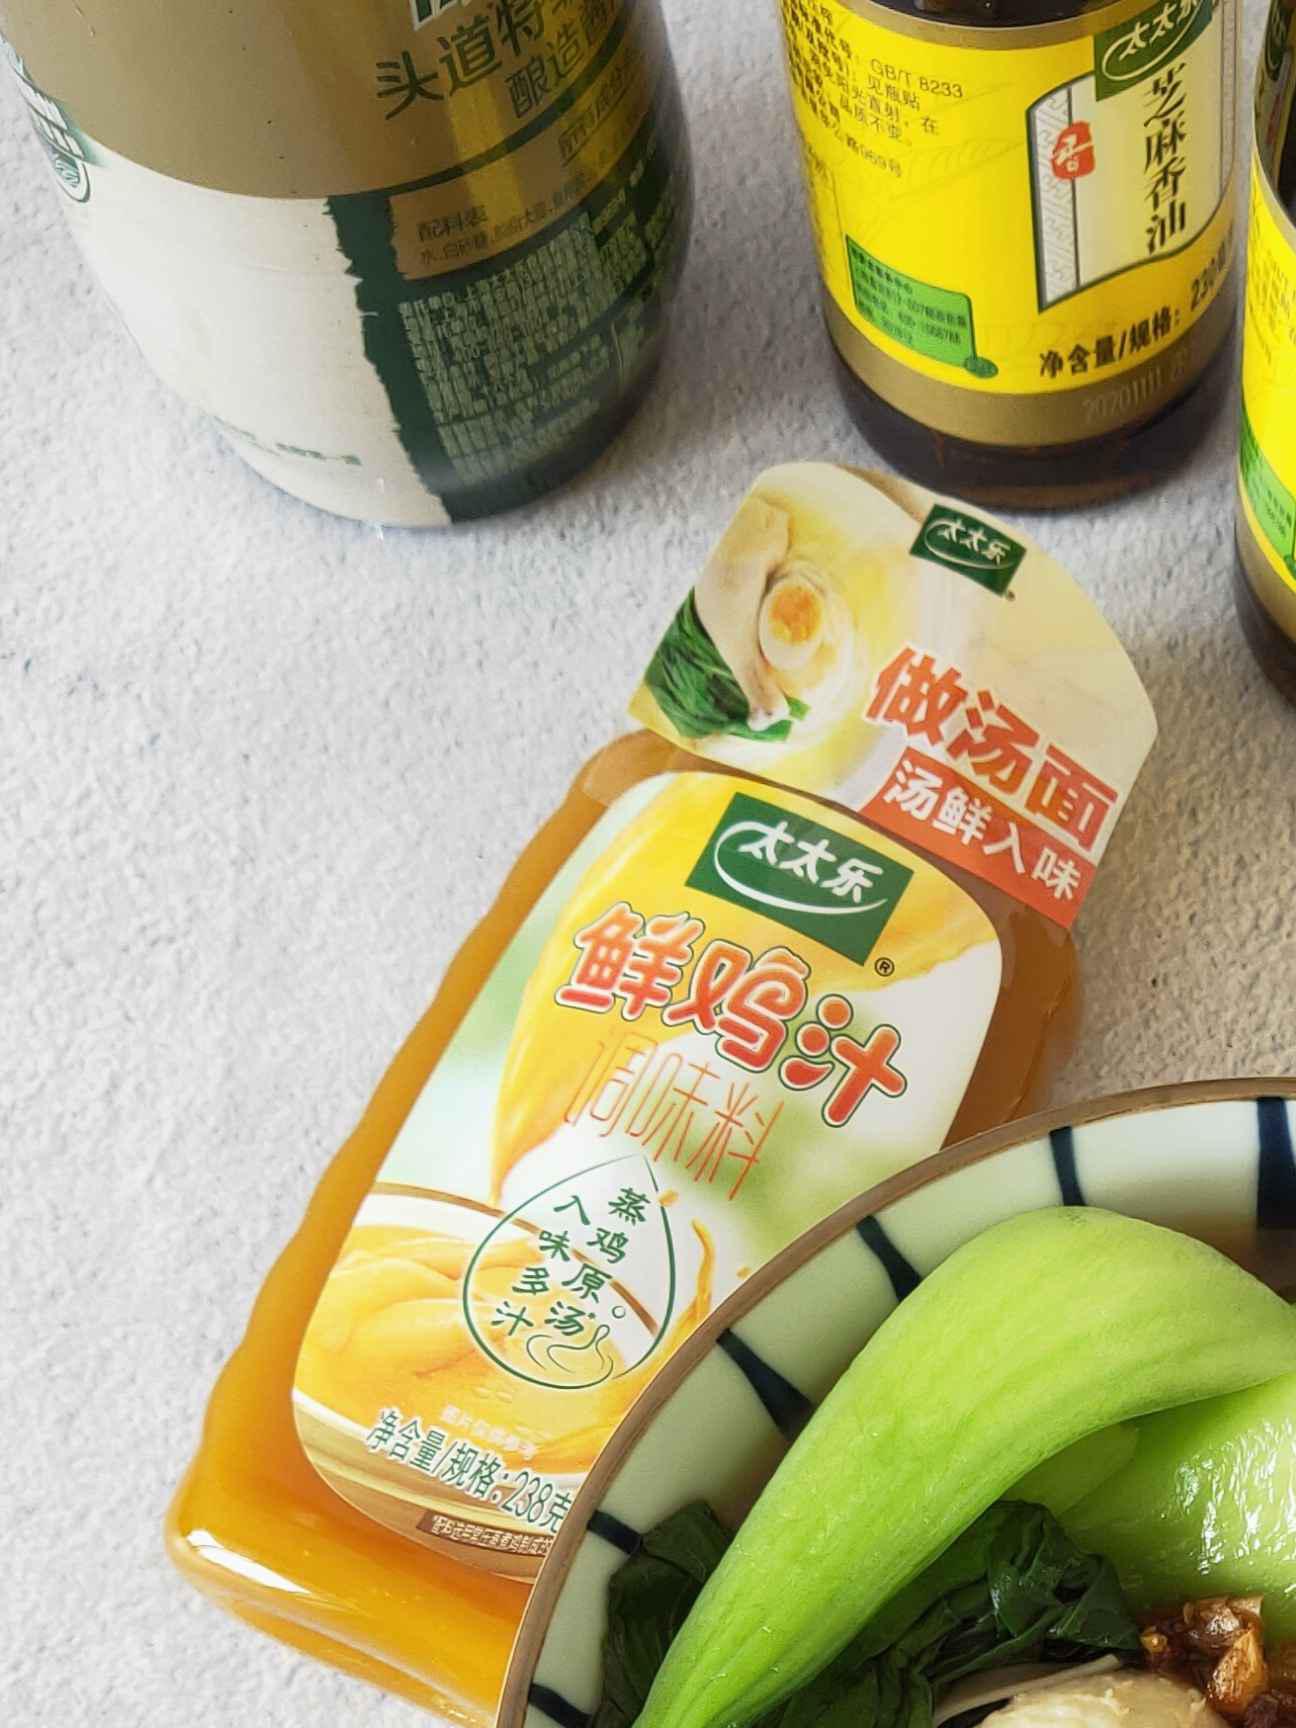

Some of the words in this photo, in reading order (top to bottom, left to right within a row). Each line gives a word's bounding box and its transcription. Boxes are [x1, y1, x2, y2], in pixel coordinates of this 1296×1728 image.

[376, 0, 575, 120] 头道特
[870, 59, 911, 87] GB/T
[919, 76, 963, 99] 8233
[1144, 62, 1187, 255] 芝麻香油
[937, 517, 1012, 566] 太太乐
[865, 646, 1119, 855] 做汤面
[739, 819, 884, 904] 太太乐
[884, 758, 1081, 900] 汤鲜入味
[555, 901, 908, 1128] 鲜鸡汁
[564, 1026, 784, 1201] 调味料
[491, 1195, 590, 1337] 入味多汁
[544, 1187, 651, 1337] 蒸鸡原汤
